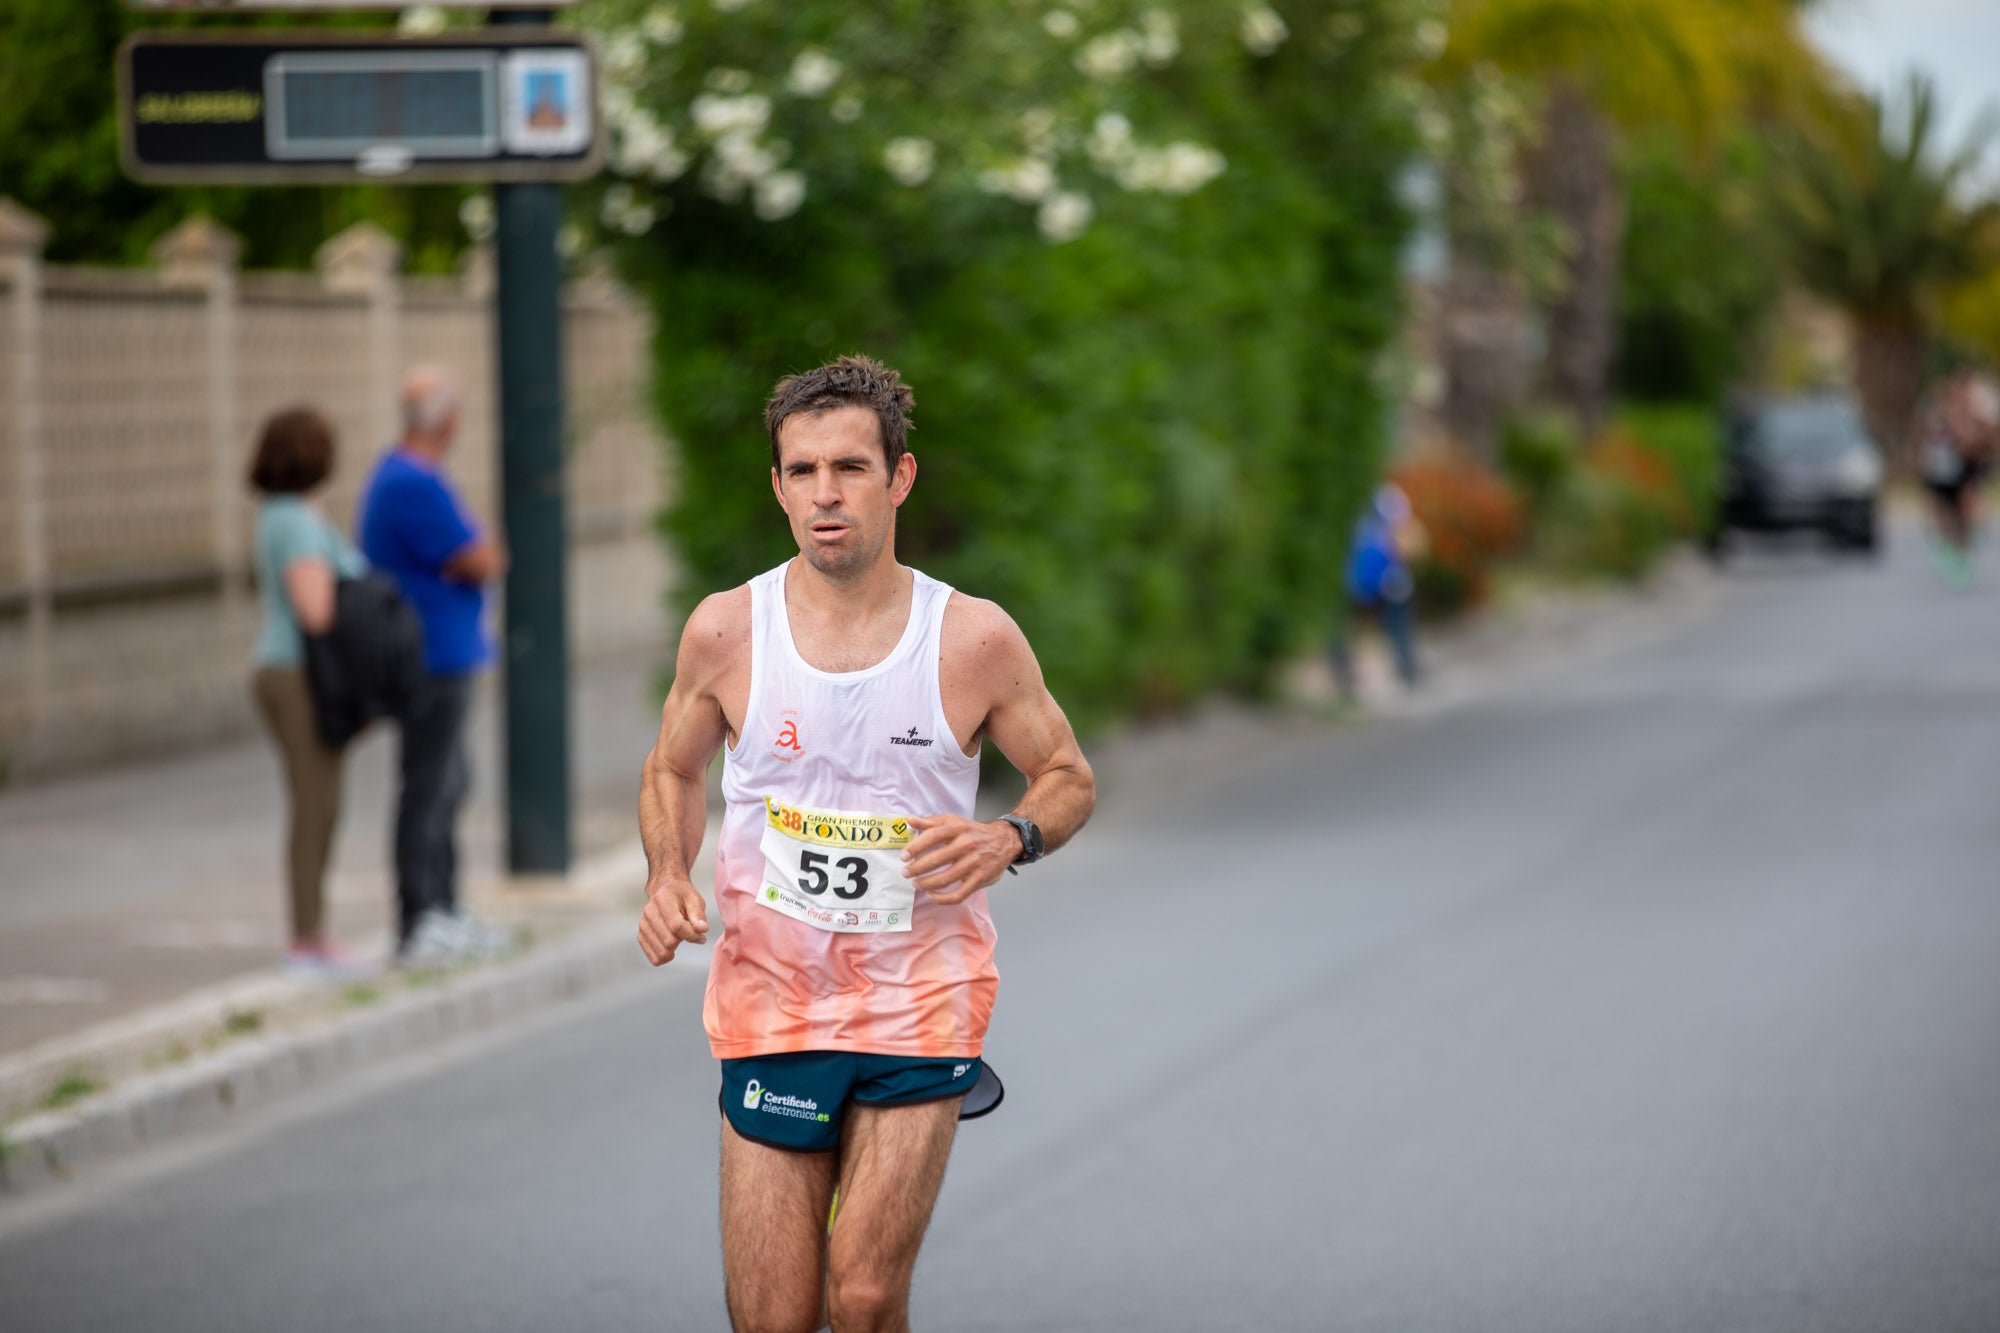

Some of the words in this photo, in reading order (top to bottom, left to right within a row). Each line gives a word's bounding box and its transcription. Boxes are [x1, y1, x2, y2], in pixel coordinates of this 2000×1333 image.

[890, 736, 934, 747] TEAMERGY
[781, 808, 802, 832] 38
[807, 814, 836, 824] GRAN
[839, 818, 876, 827] PREMIO
[802, 821, 883, 842] FONDO
[797, 849, 869, 900] 53
[764, 1091, 818, 1111] Certificado
[761, 1102, 830, 1123] electronico.es
